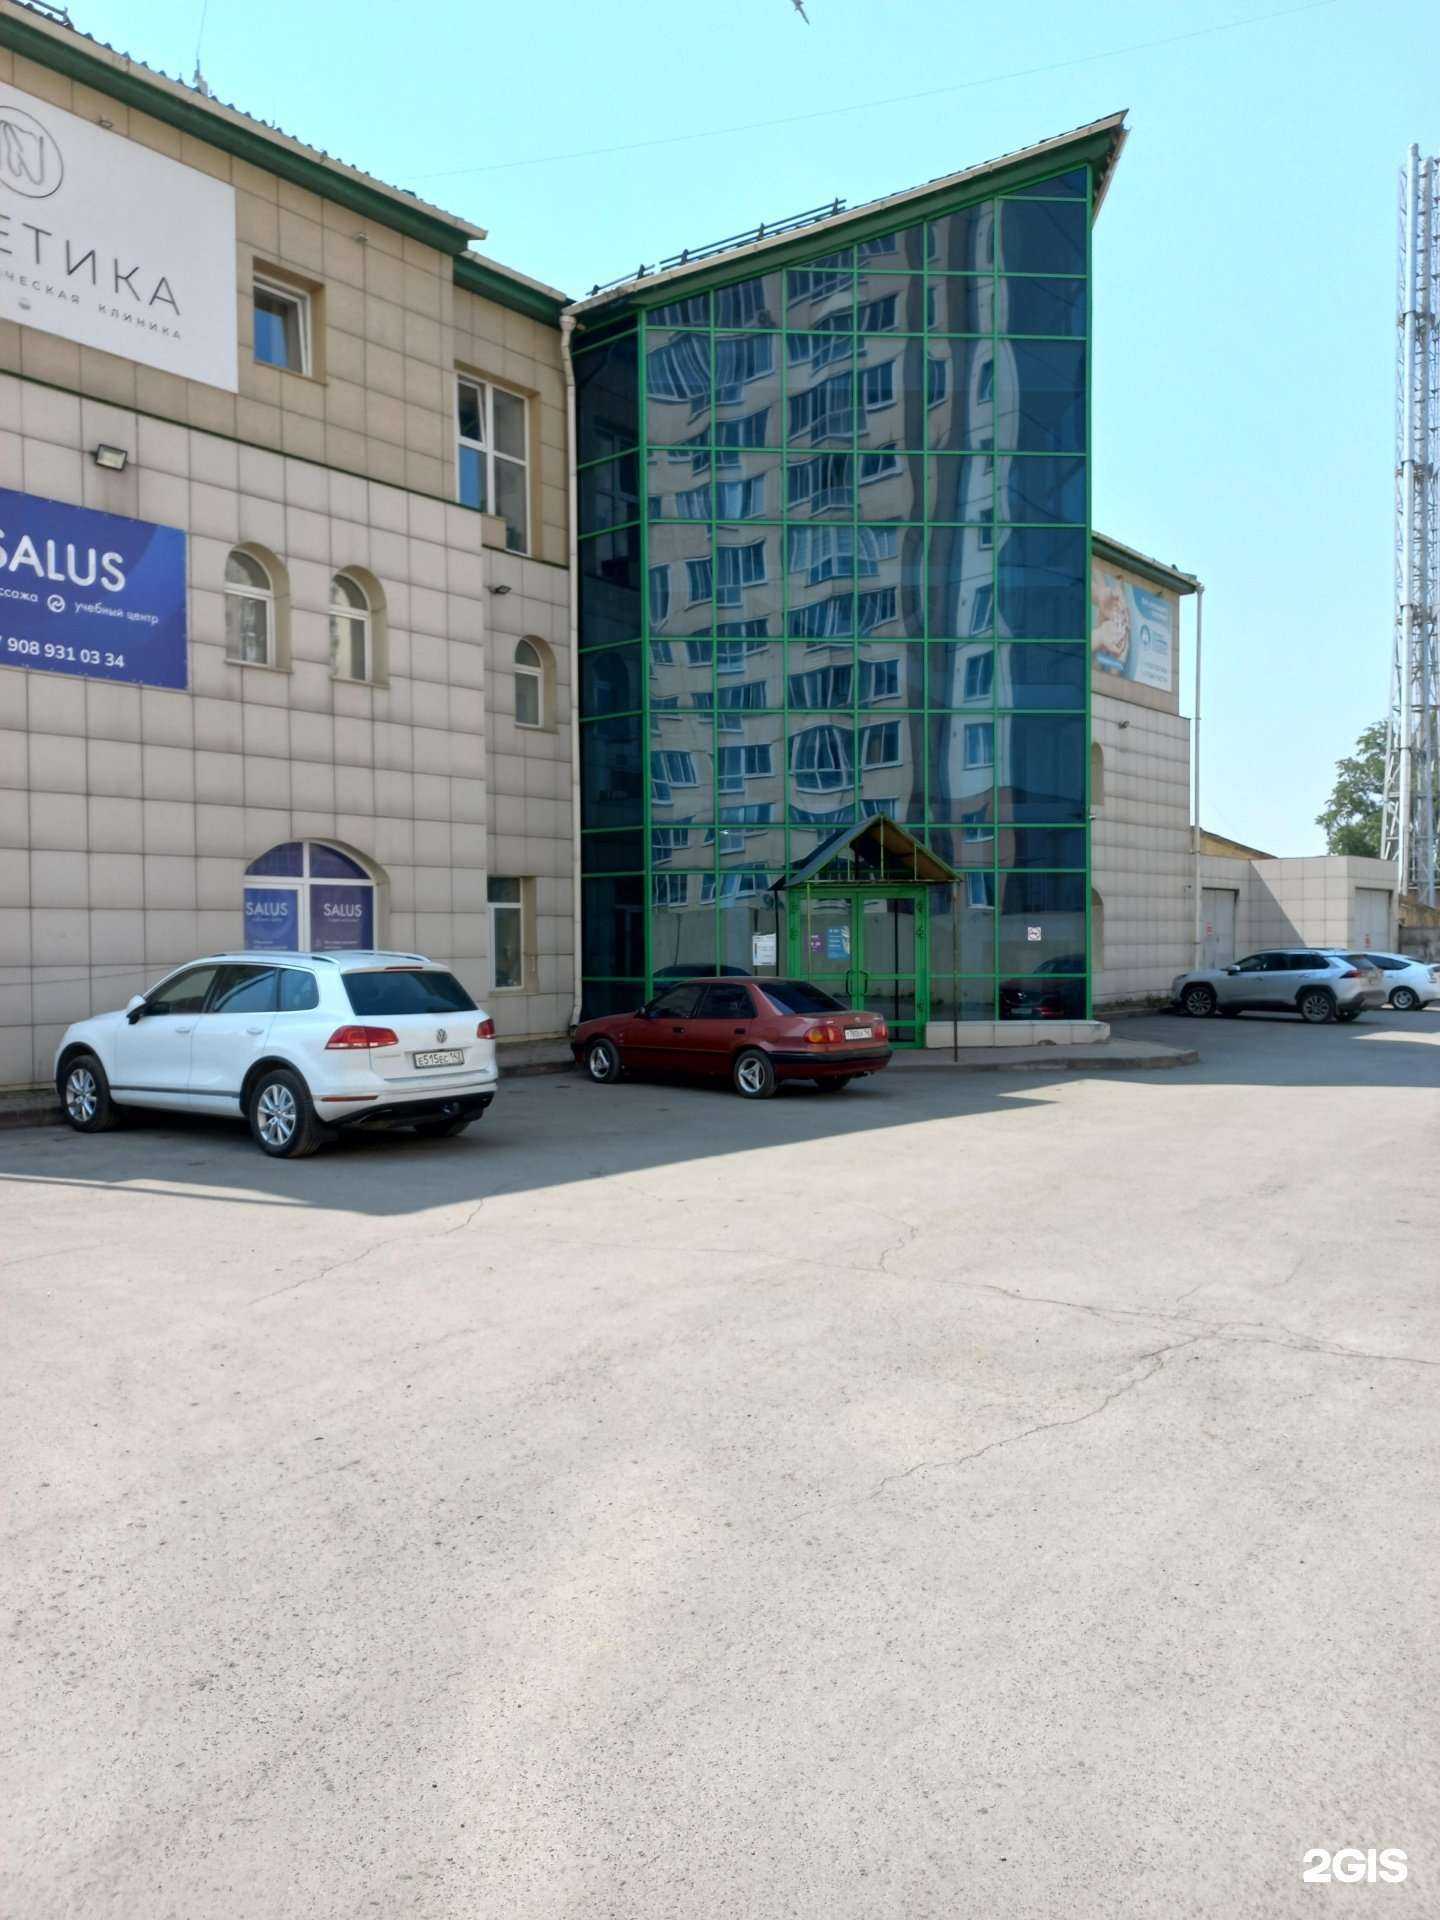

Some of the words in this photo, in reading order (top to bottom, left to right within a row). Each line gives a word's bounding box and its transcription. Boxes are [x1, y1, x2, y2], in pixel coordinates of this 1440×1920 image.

[0, 269, 80, 305] ЧЕСКАЯ
[98, 303, 182, 341] КЛИНИКА
[0, 527, 127, 593] ALUS
[74, 602, 124, 619] учебный
[126, 609, 159, 625] центр
[7, 637, 40, 655] 908
[44, 643, 76, 662] 931
[80, 648, 101, 665] 03
[104, 652, 126, 668] 34
[246, 902, 288, 916] SALUS
[323, 903, 362, 917] SALUS
